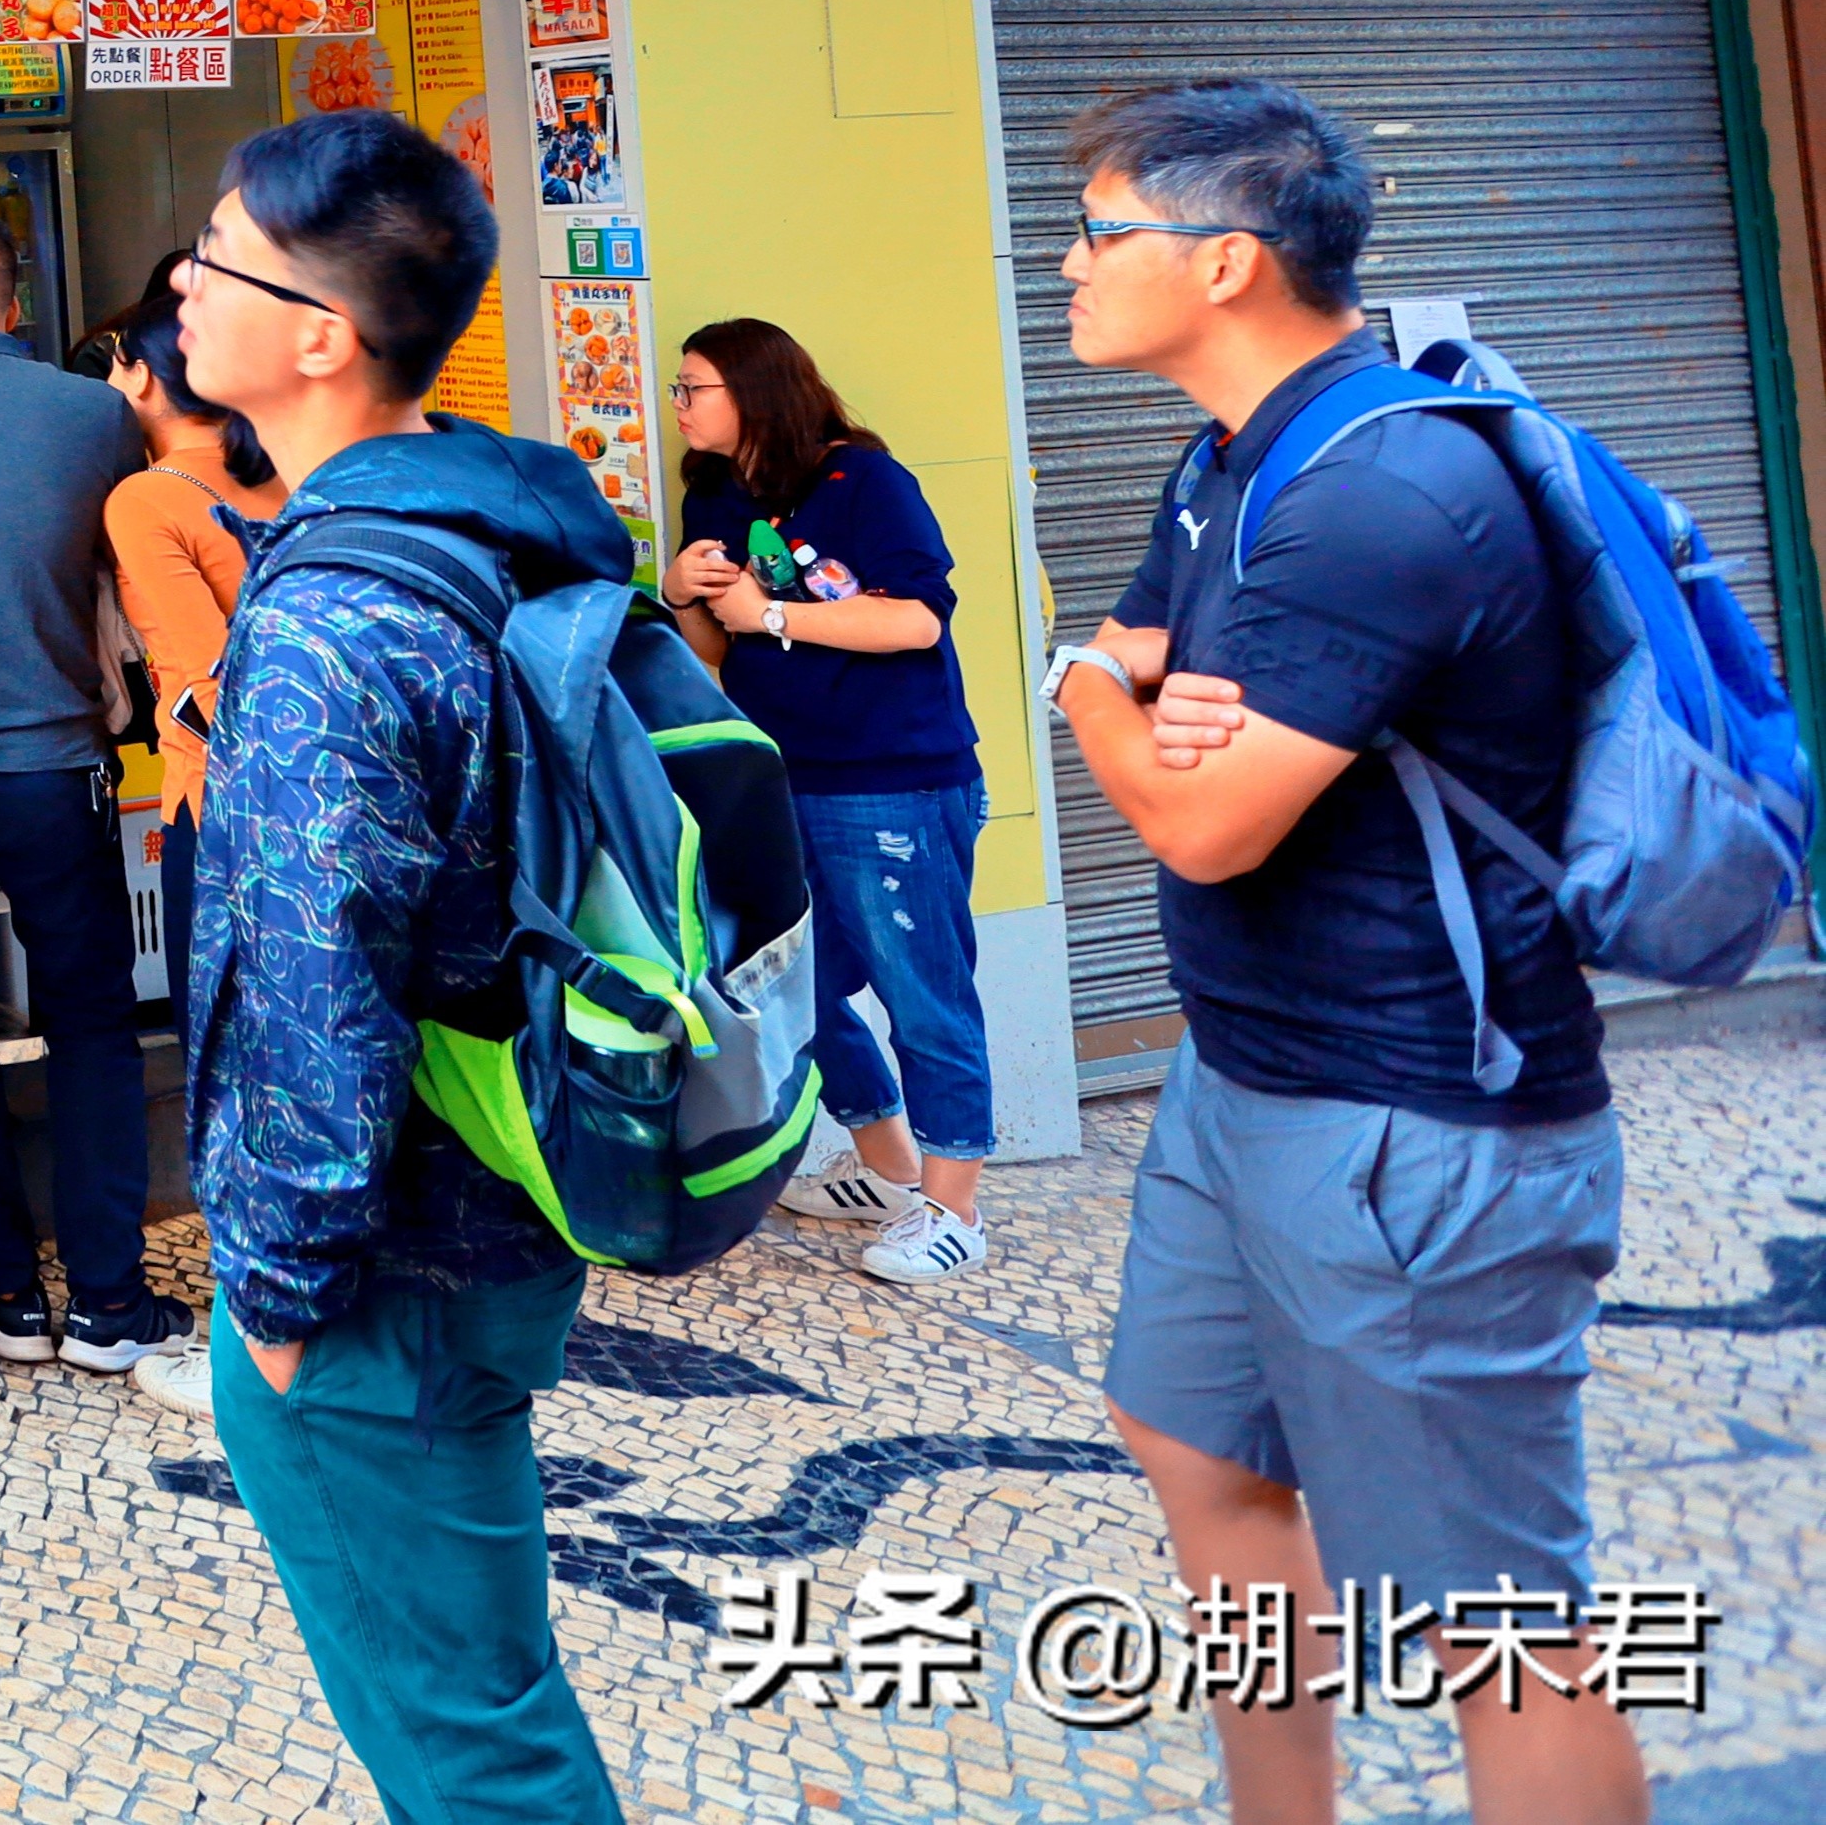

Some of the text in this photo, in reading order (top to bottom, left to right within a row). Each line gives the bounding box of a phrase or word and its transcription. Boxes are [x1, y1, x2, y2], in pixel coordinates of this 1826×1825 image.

[543, 17, 596, 34] MASALA
[92, 47, 142, 64] 先點餐
[149, 47, 227, 82] 點餐區
[91, 69, 142, 84] ORDER
